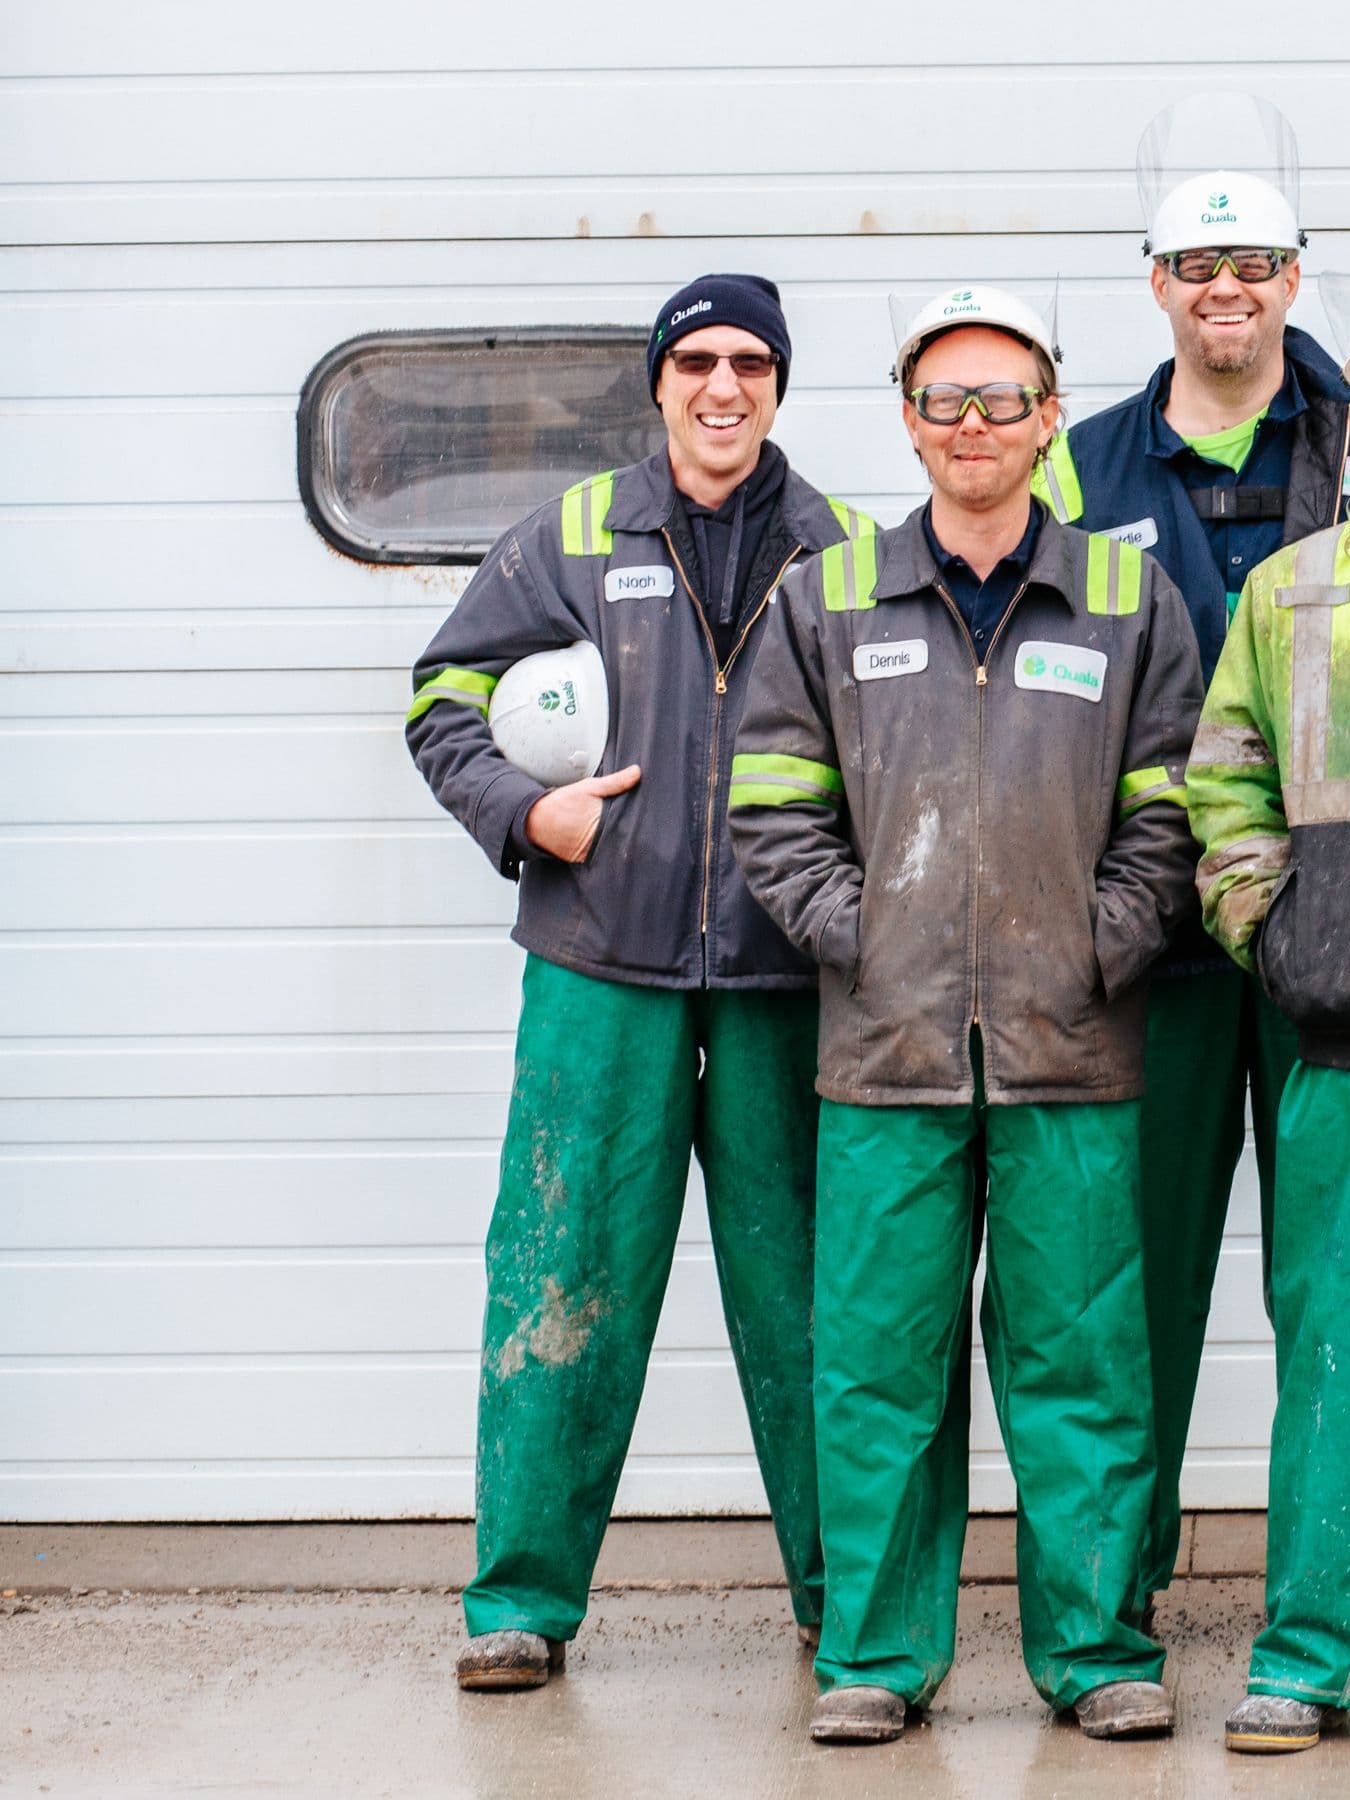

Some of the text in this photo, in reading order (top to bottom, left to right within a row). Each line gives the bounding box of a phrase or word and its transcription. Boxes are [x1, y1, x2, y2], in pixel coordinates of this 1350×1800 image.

[1201, 212, 1237, 224] Quala
[671, 299, 712, 326] Quala
[618, 575, 656, 590] Noah
[869, 651, 911, 669] Dennis
[1053, 664, 1099, 688] Quala
[563, 680, 577, 716] Quala
